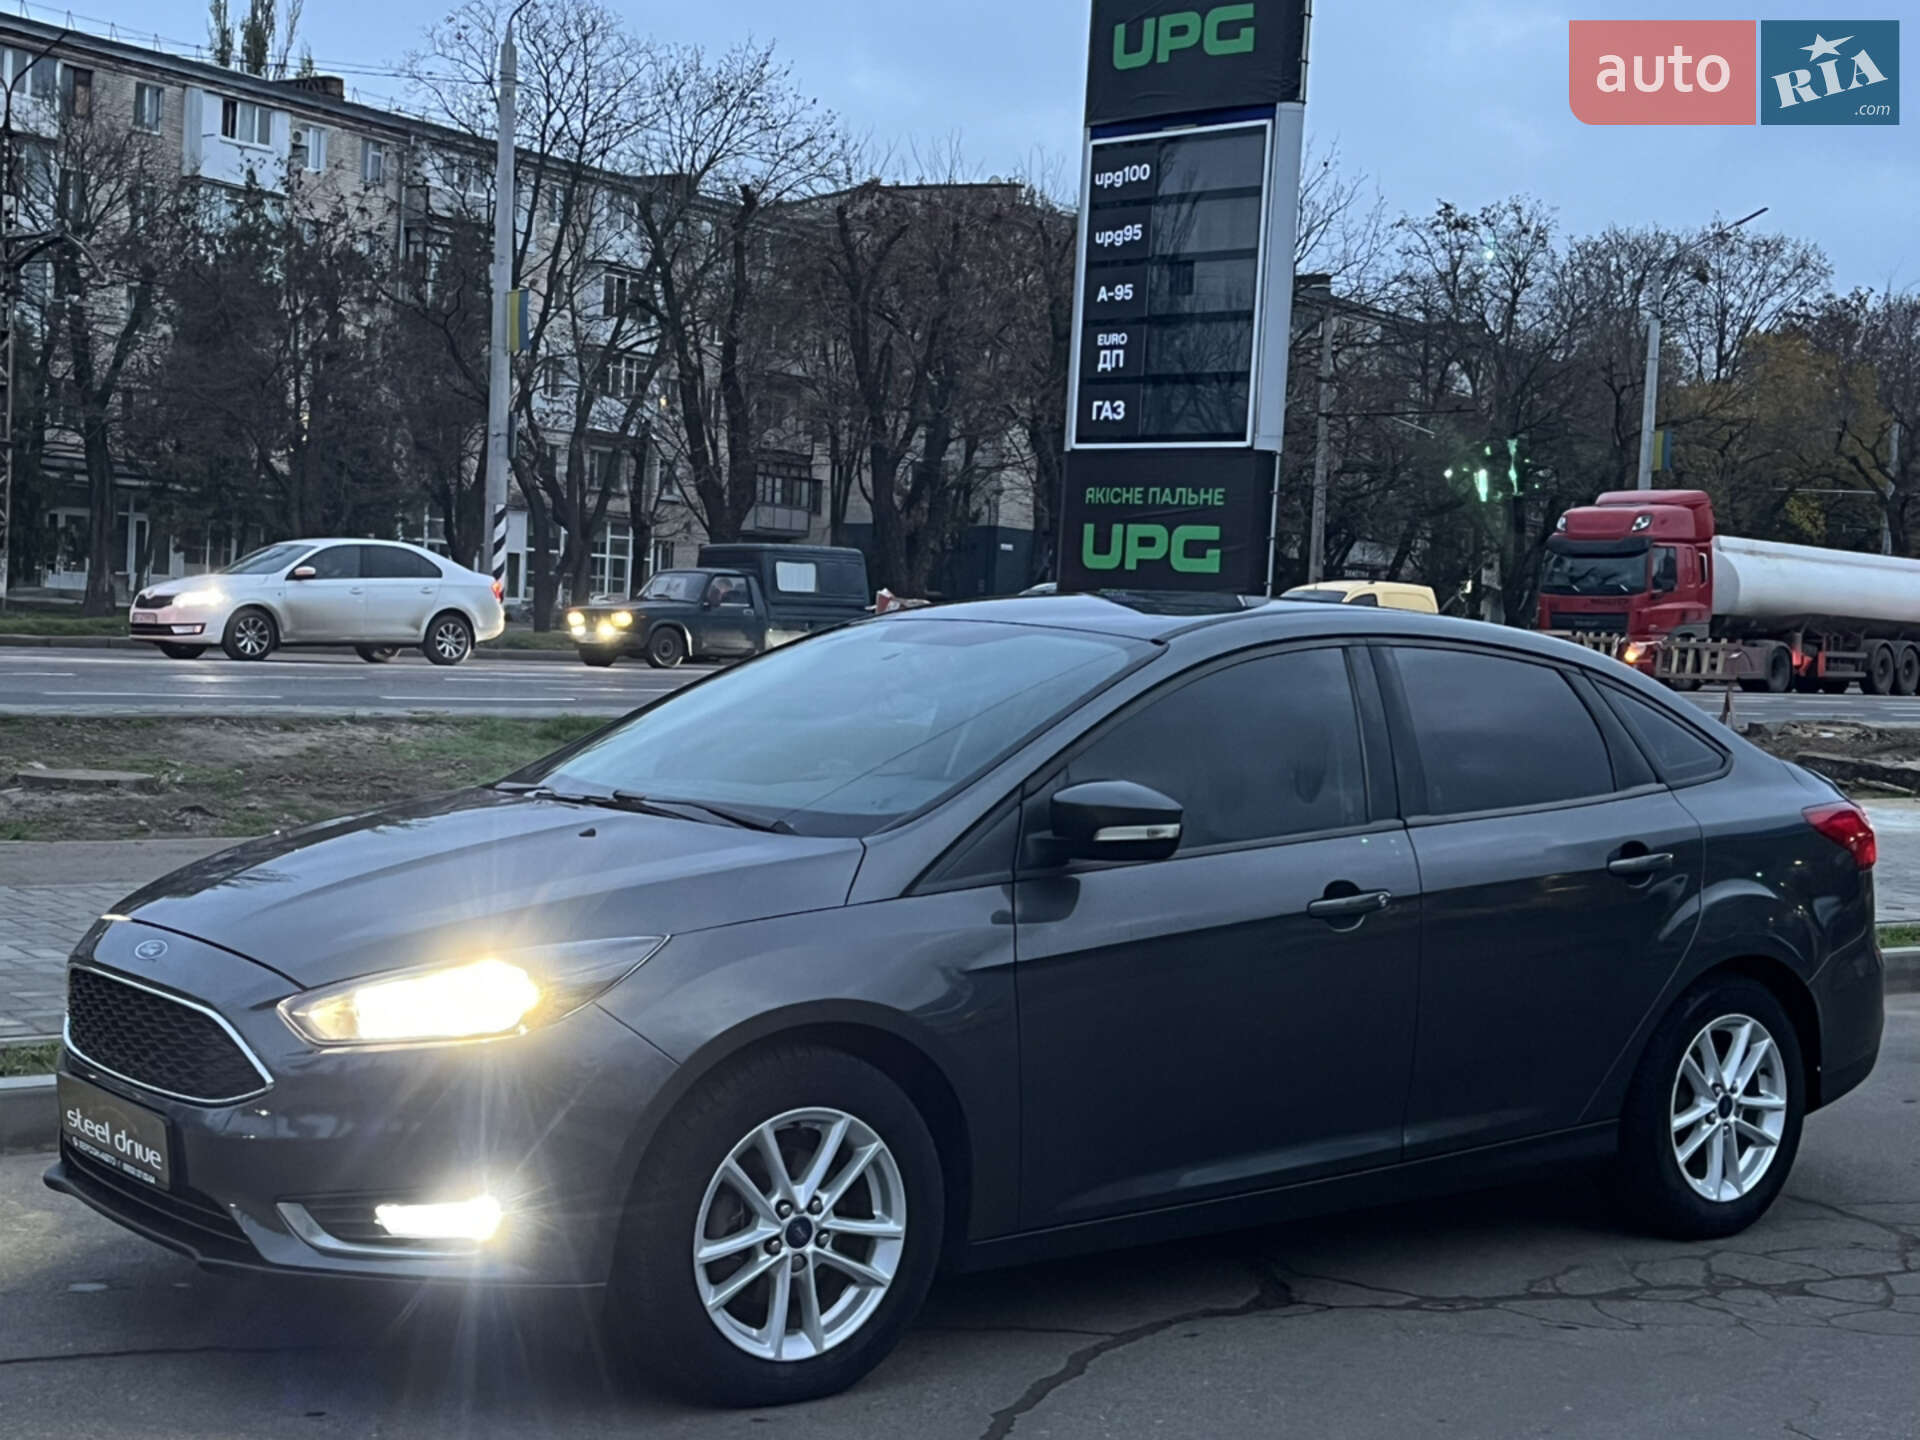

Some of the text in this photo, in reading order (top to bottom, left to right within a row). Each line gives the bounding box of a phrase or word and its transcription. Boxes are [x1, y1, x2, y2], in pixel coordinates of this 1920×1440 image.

[1113, 3, 1255, 70] UPG
[1095, 163, 1150, 188] upg100
[1095, 224, 1142, 248] upg95
[1097, 333, 1127, 346] EURO
[1097, 349, 1124, 372] ДП
[1091, 400, 1125, 420] ГАЗ
[1085, 487, 1226, 506] ЯКІСНЕ ПАЛЬНЕ
[1082, 523, 1221, 573] UPG
[67, 1108, 110, 1144] steel
[114, 1130, 162, 1170] drive
